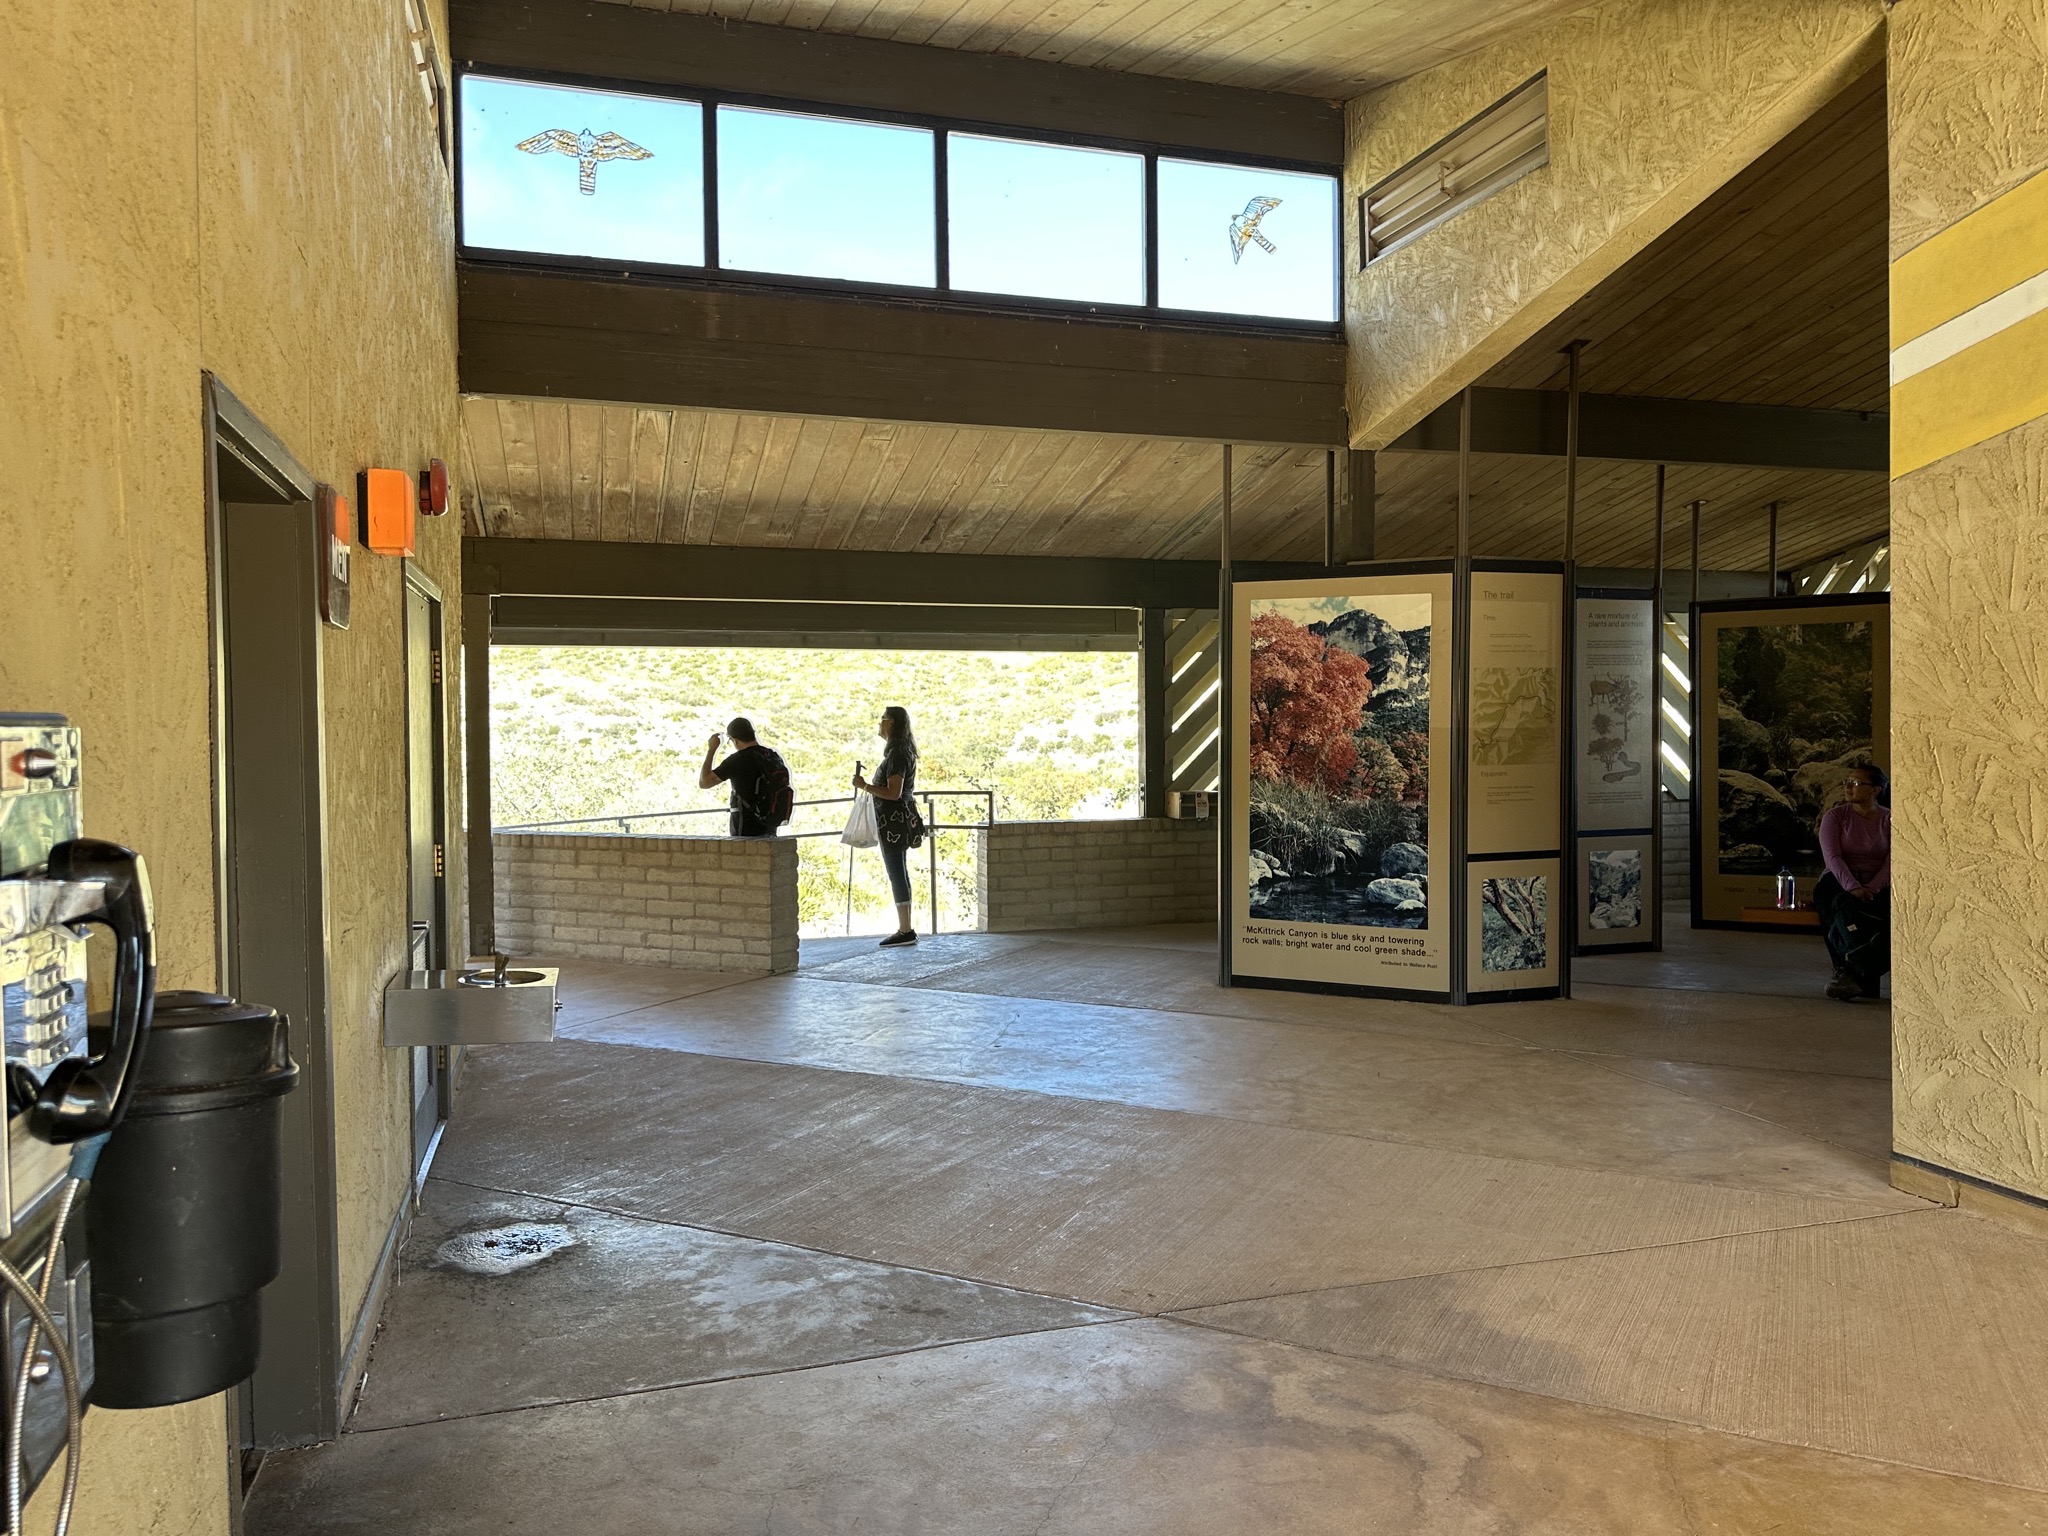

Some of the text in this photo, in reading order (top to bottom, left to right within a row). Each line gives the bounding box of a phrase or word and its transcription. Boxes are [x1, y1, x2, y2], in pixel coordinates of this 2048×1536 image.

[1482, 590, 1514, 600] The trail
[1588, 620, 1607, 628] plants
[1288, 928, 1318, 939] Canyon
[1321, 930, 1328, 939] is
[1331, 931, 1348, 940] blue
[1351, 933, 1366, 943] sky
[1369, 935, 1385, 943] and
[1388, 936, 1425, 947] towering
[1262, 938, 1283, 947] walls;
[1285, 939, 1308, 949] bright
[1311, 942, 1333, 950] water
[1353, 945, 1372, 953] cool
[1374, 947, 1398, 955] green
